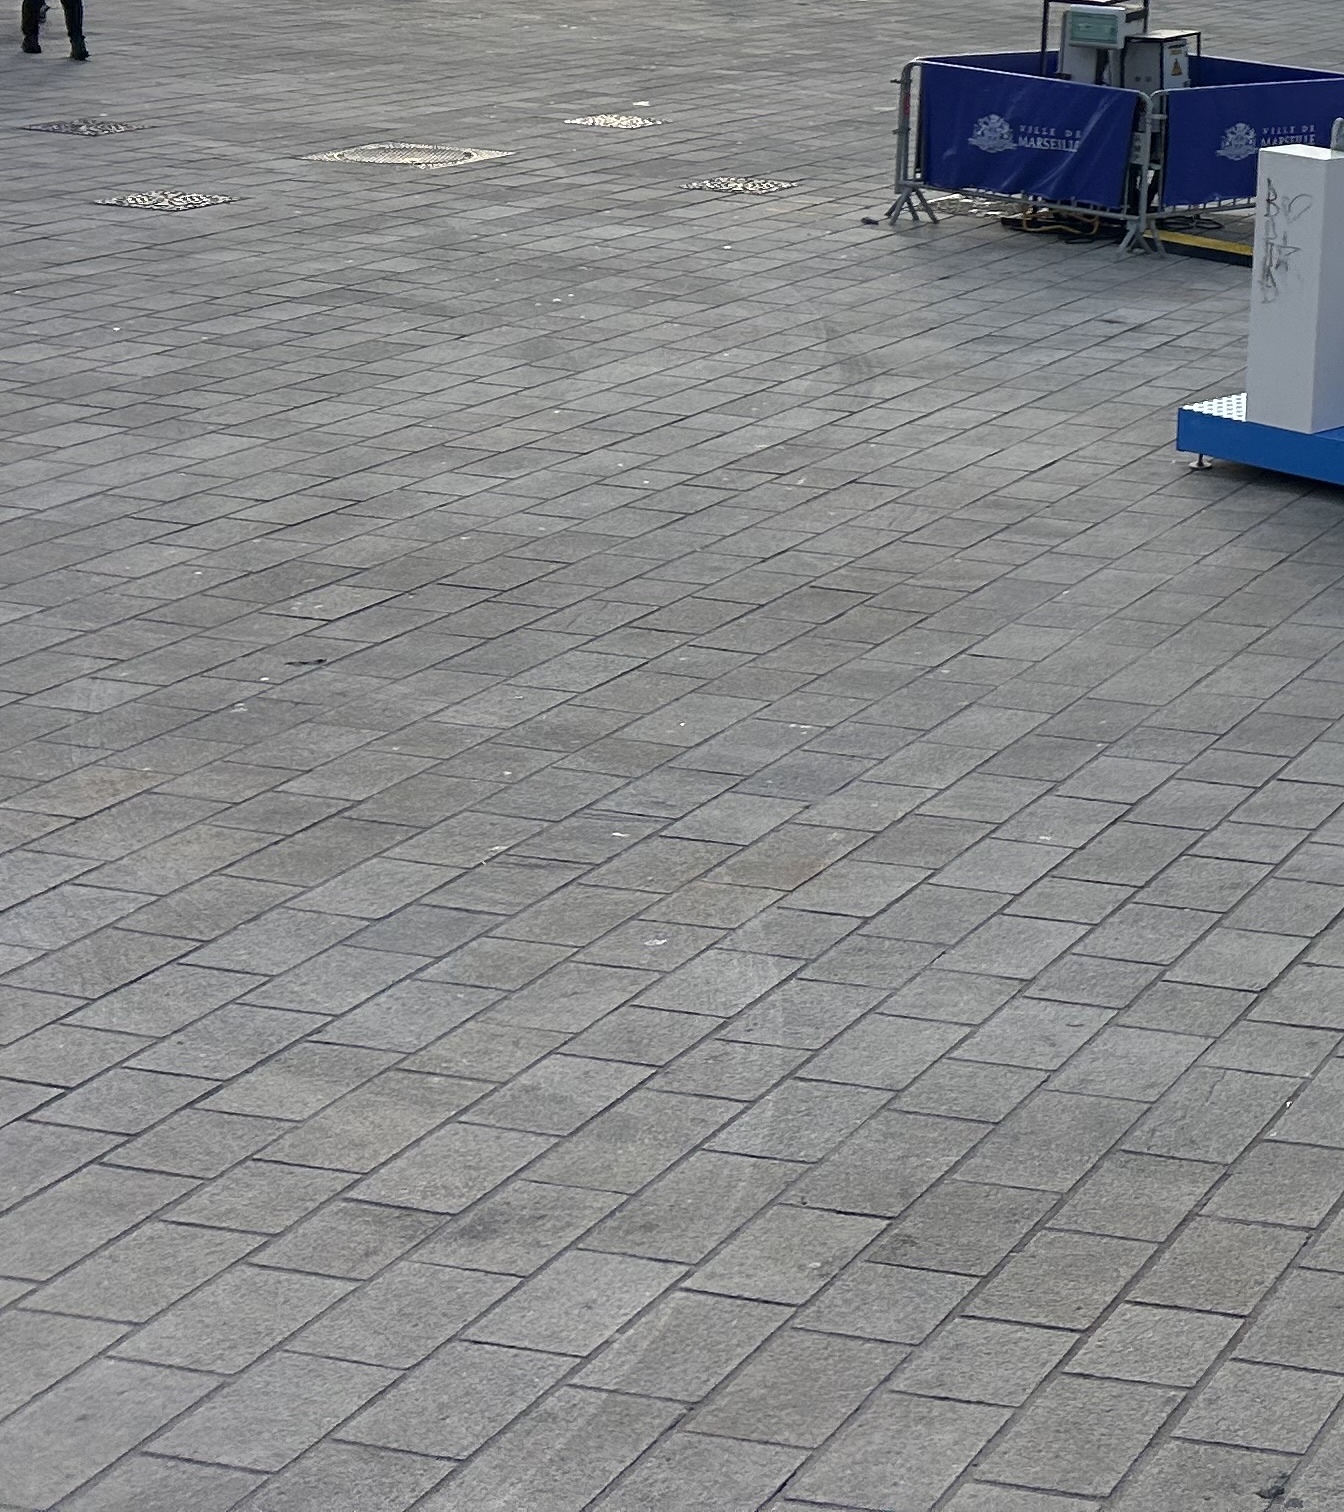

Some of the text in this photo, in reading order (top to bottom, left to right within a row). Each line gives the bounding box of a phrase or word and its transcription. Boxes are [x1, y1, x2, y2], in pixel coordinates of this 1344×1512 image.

[1020, 125, 1056, 136] VILLE
[1262, 125, 1296, 135] VILLE
[1018, 136, 1081, 153] MARSEILLE
